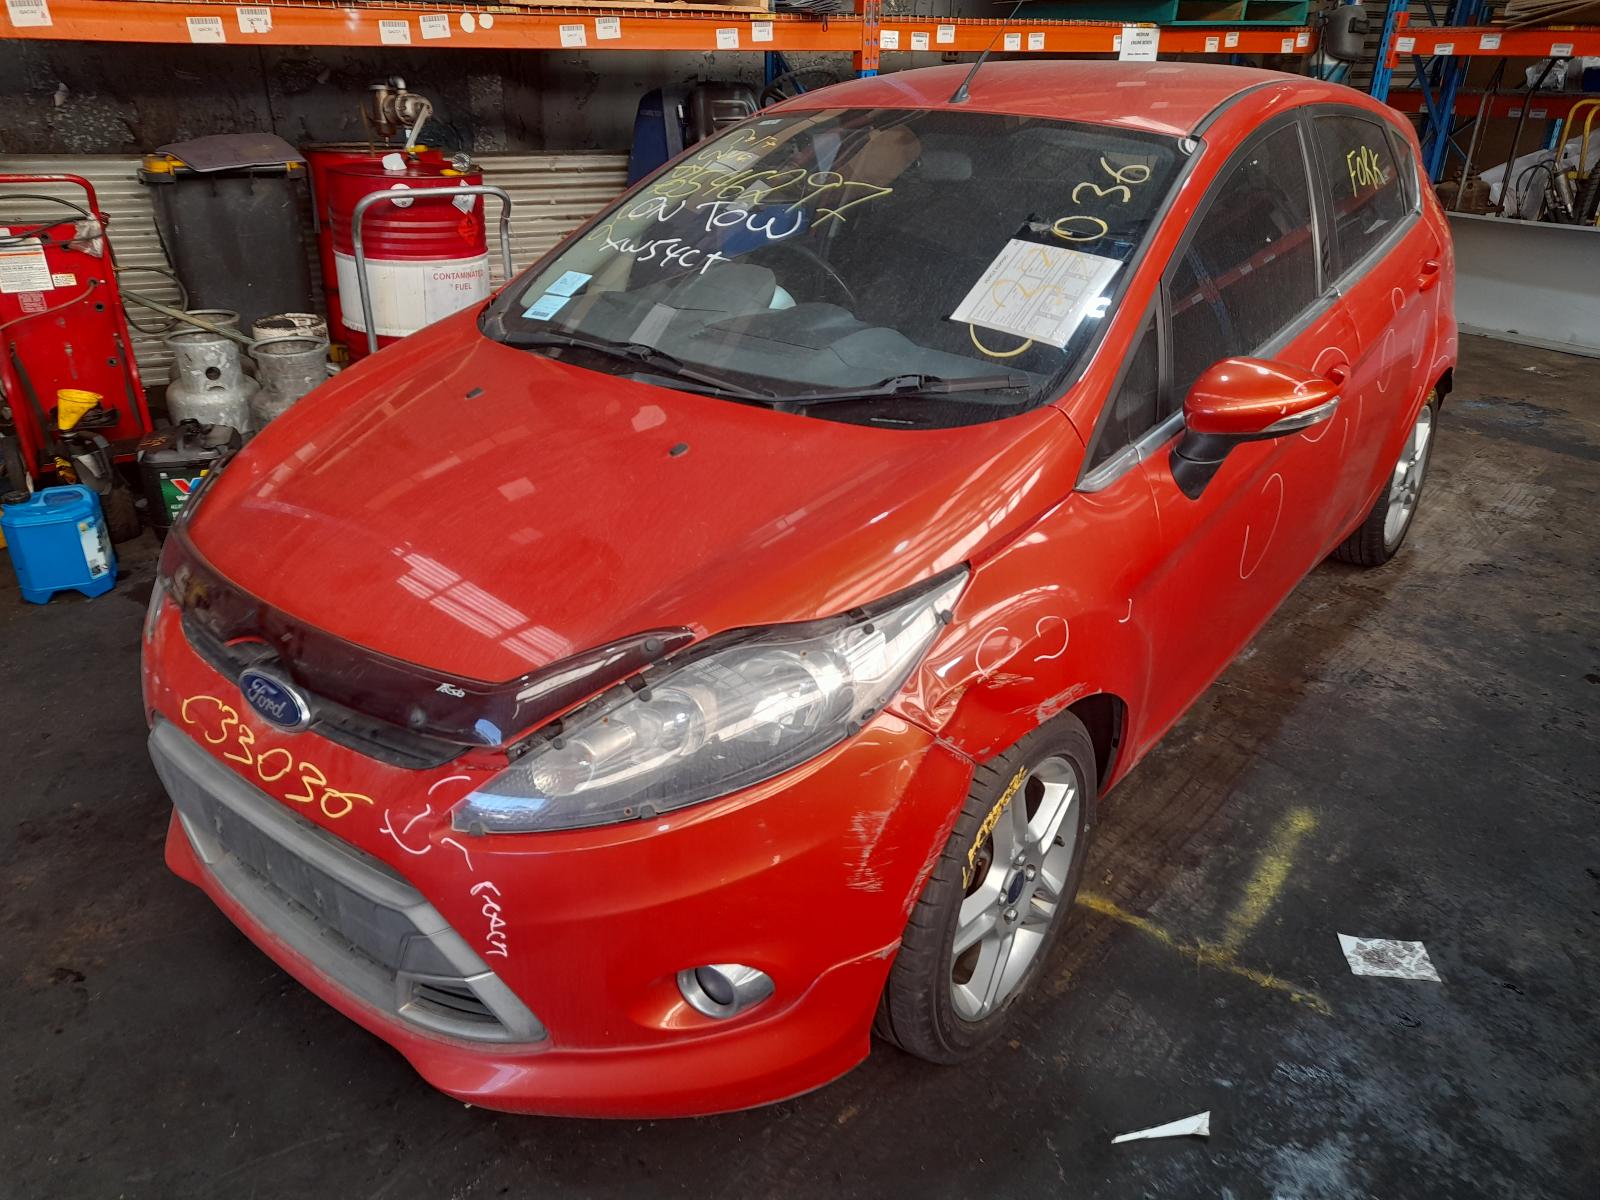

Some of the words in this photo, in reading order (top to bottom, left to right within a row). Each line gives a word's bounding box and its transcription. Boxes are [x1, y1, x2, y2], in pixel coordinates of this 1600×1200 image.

[1347, 146, 1386, 198] FORK
[696, 201, 802, 239] TOW
[248, 678, 286, 719] Ford
[181, 695, 374, 818] C33036
